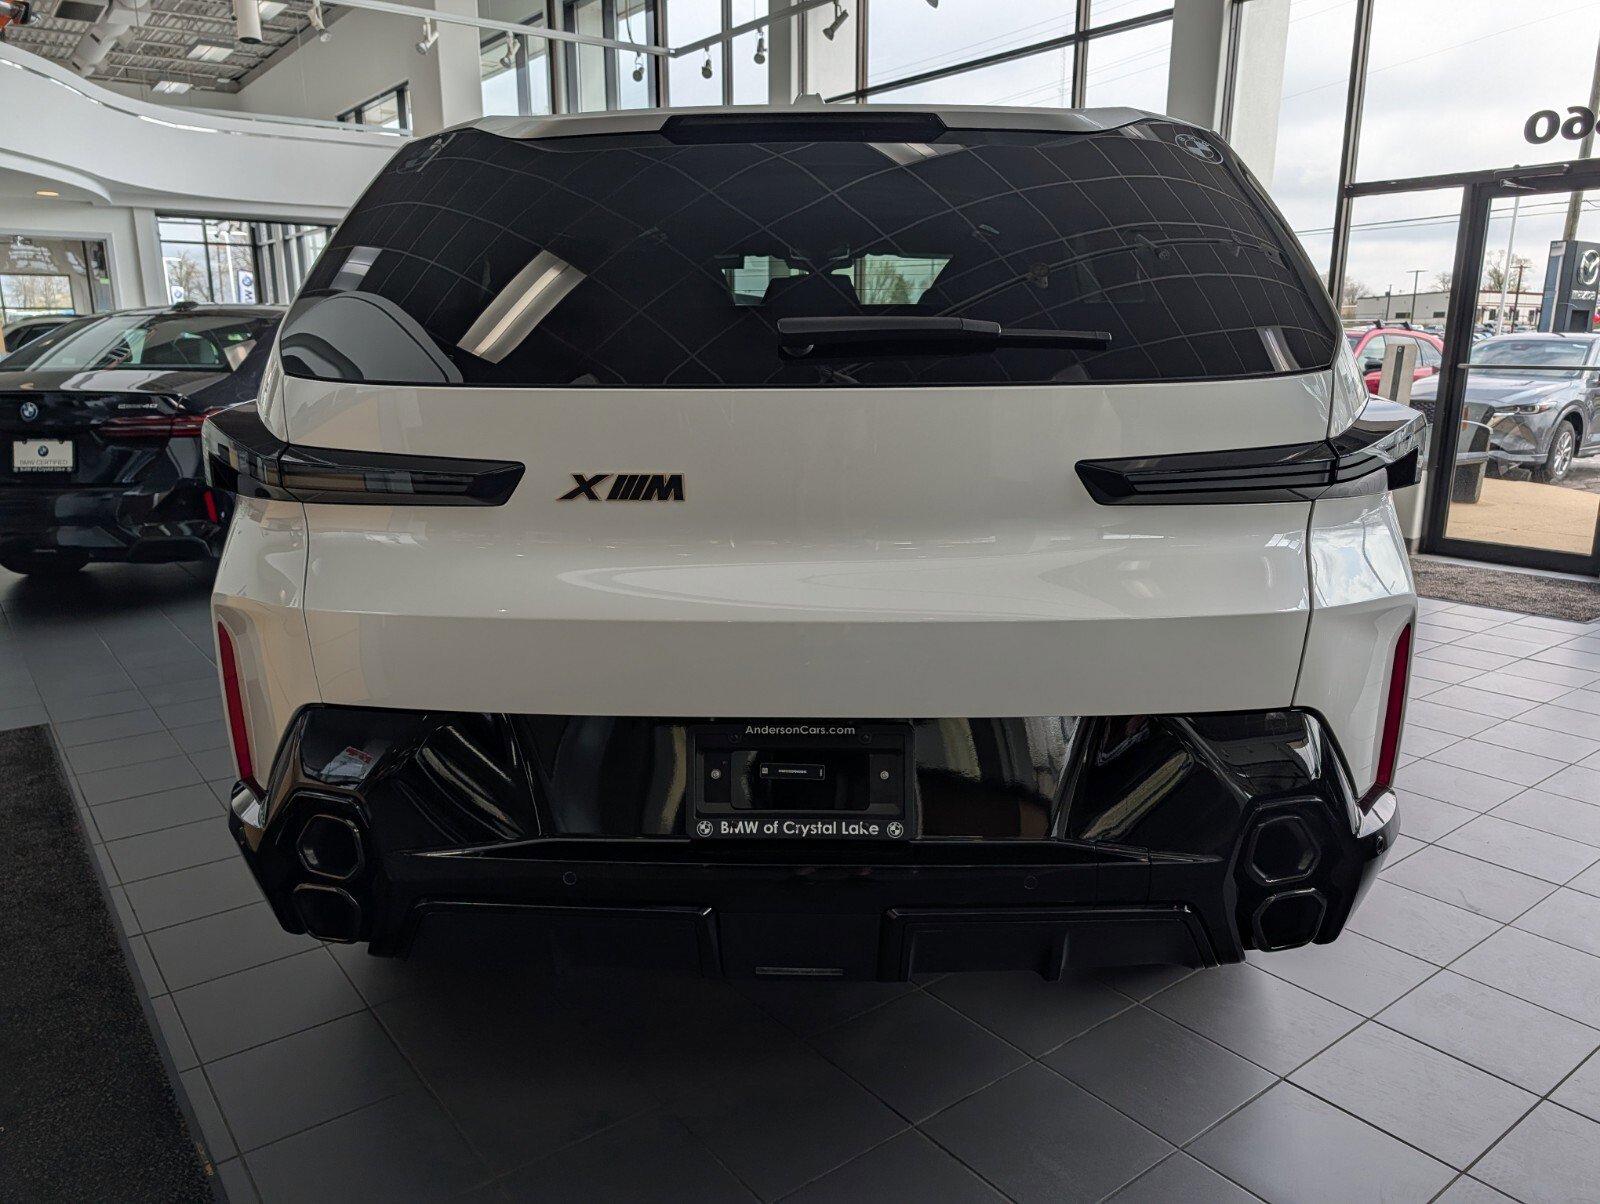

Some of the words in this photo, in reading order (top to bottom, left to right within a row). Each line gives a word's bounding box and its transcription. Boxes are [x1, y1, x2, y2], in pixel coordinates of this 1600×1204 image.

[745, 725, 856, 735] AndersonCars.com
[720, 820, 759, 834] BMW
[764, 821, 779, 835] of
[783, 821, 837, 838] Crystal
[842, 821, 880, 835] Lake
